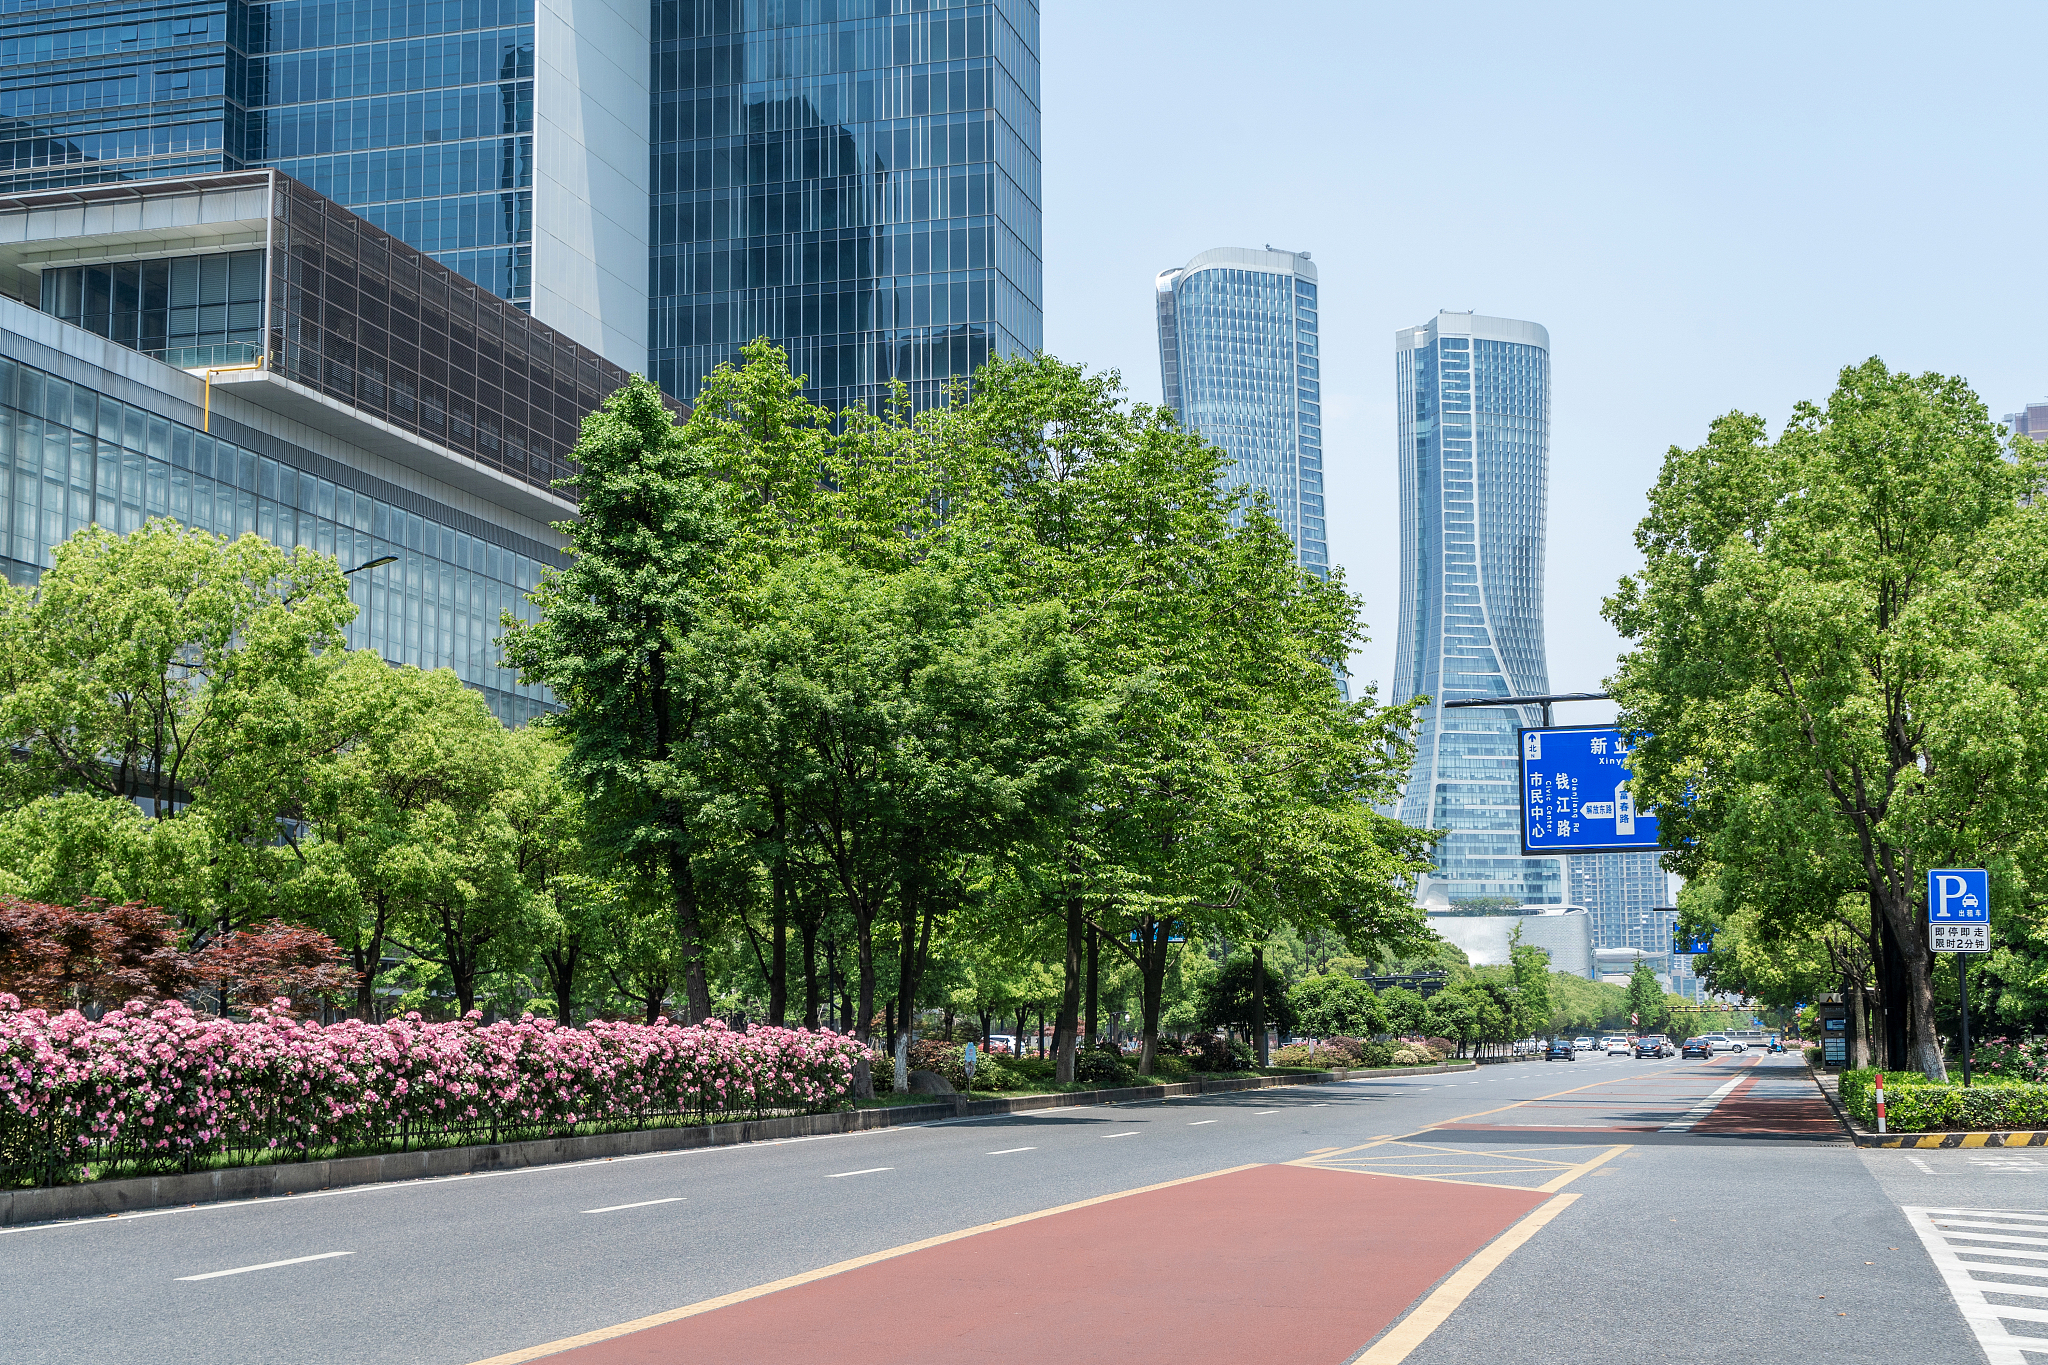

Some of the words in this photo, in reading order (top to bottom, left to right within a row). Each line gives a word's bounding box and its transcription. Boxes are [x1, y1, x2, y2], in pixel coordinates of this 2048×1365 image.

[1528, 744, 1537, 752] 北
[1599, 757, 1622, 765] Xiny
[1545, 780, 1553, 801] Civic
[1571, 777, 1579, 818] Qianjiang
[1529, 771, 1545, 838] 市民中心
[1555, 772, 1571, 837] 钱江路
[1619, 789, 1629, 824] 富春路
[1573, 822, 1580, 833] Rd
[1936, 876, 1967, 916] P
[1959, 909, 1981, 917] 出租车
[1935, 927, 1984, 937] 即停即走
[1935, 938, 1985, 949] 限时2分钟
